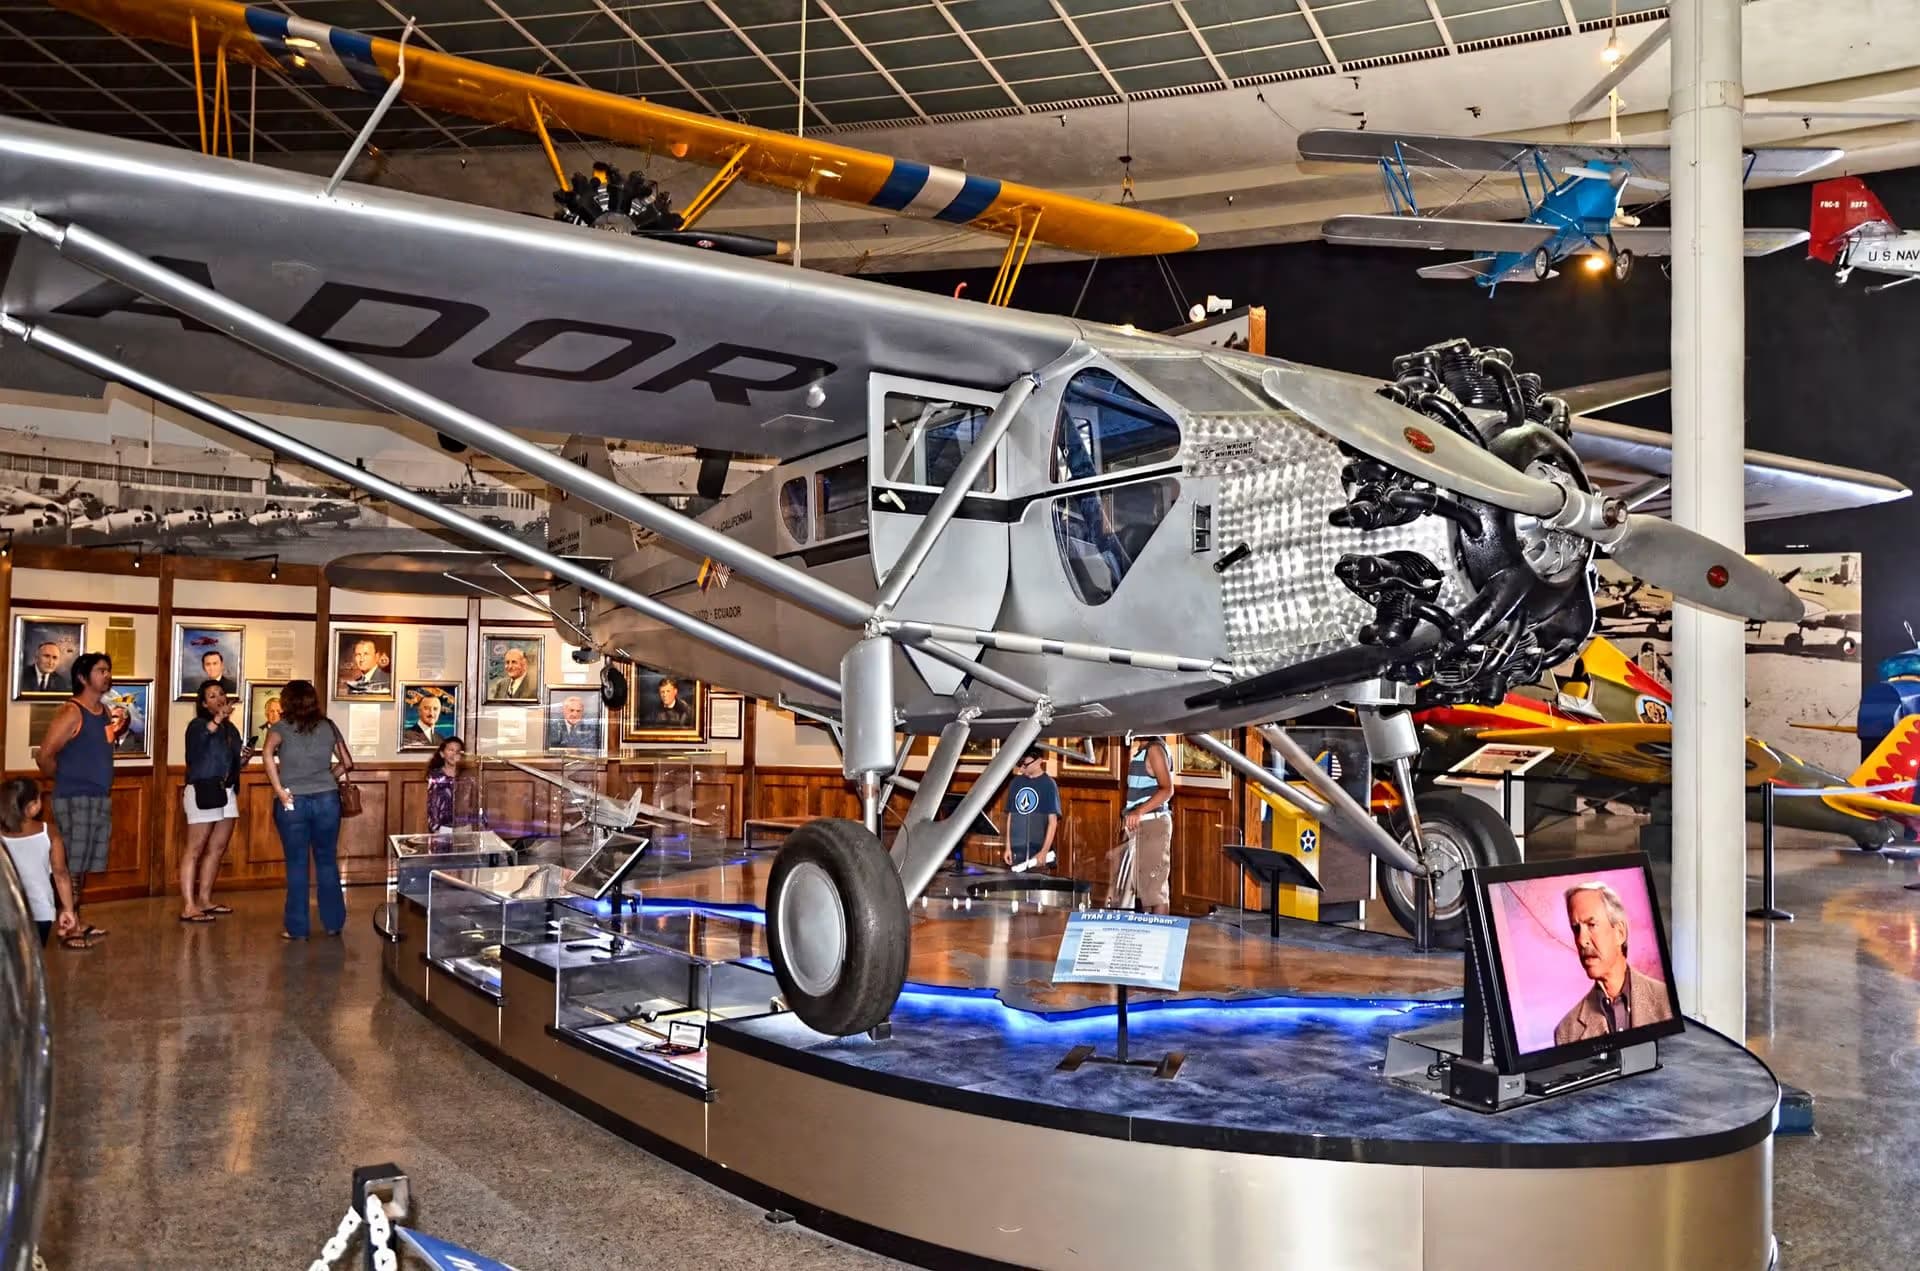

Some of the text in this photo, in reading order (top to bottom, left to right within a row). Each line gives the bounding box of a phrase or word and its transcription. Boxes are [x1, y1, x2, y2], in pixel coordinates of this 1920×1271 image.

[0, 233, 838, 406] ADOR
[1226, 441, 1252, 450] WRIGHT
[1215, 448, 1253, 457] WHIRLWIND
[720, 509, 753, 533] CALIFORNIA
[714, 606, 742, 620] ECUADOR
[1081, 912, 1104, 921] RYAN
